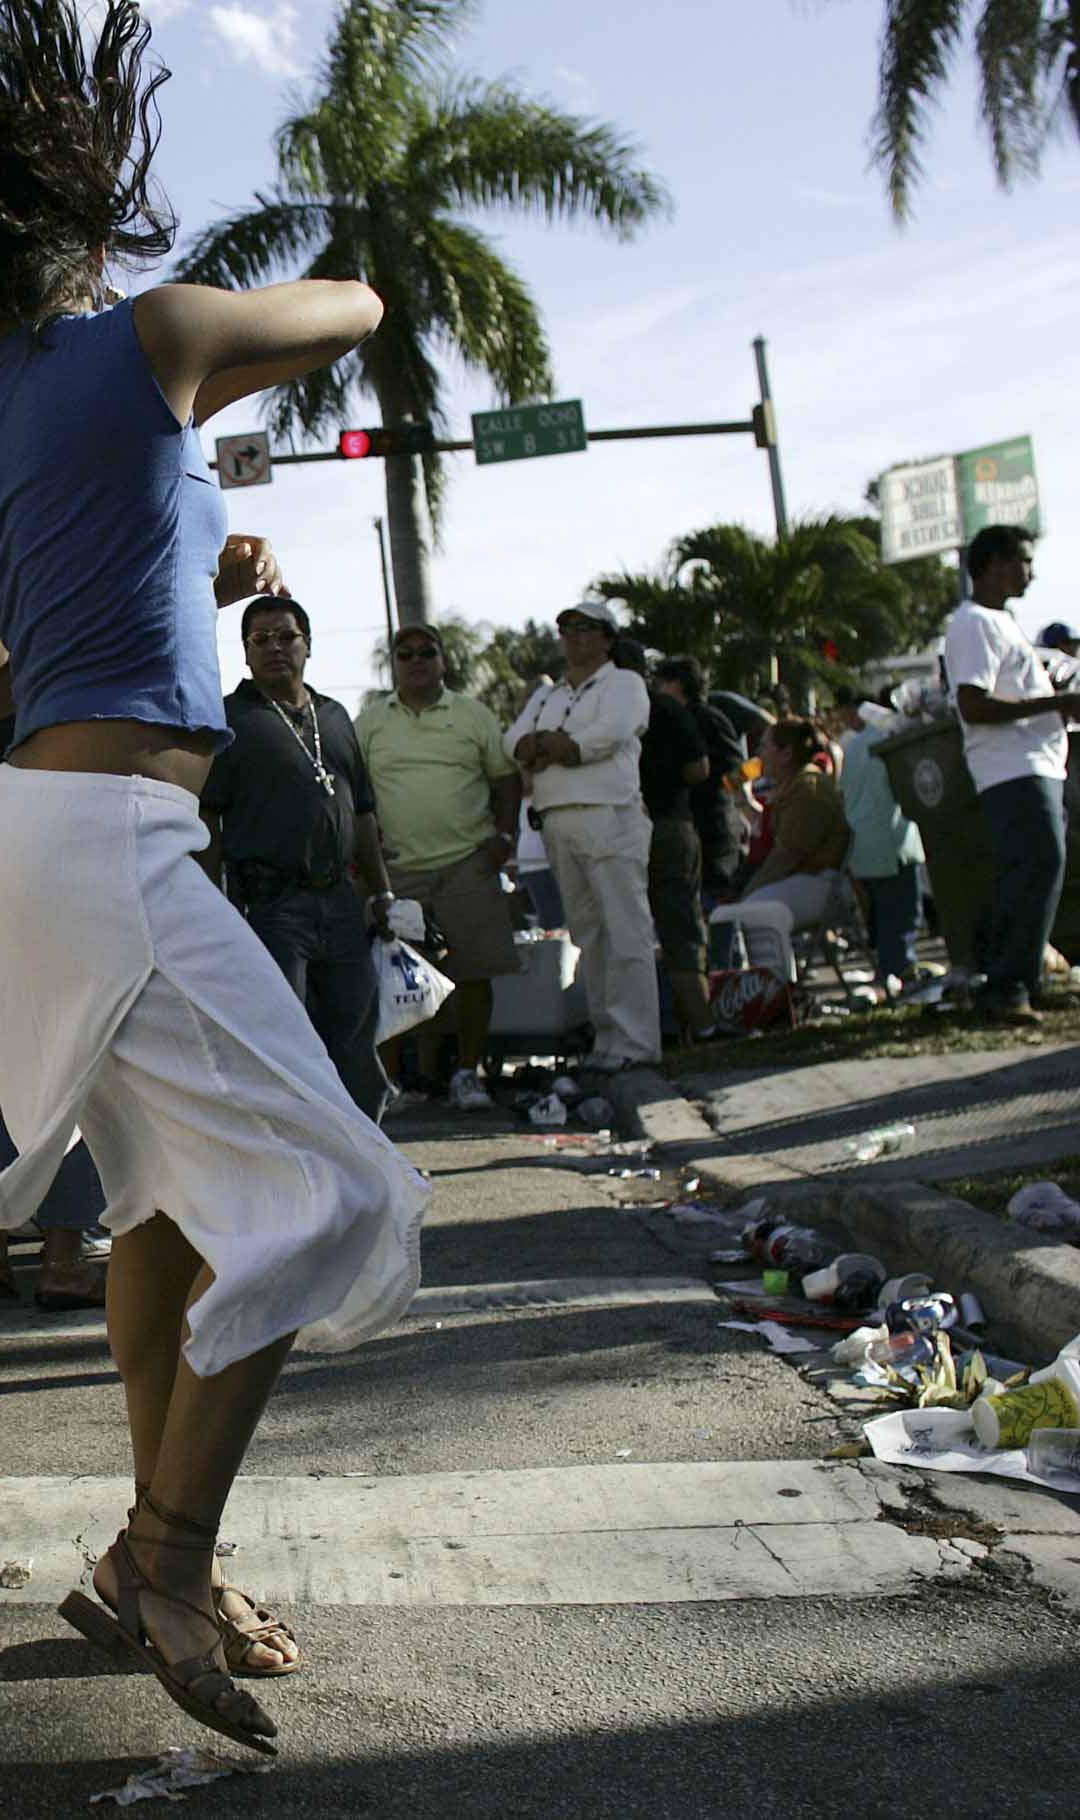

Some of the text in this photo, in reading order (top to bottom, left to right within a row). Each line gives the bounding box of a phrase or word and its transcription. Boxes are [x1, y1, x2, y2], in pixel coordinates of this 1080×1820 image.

[477, 405, 579, 434] CALLE OCHO
[480, 428, 580, 458] SW 8 ST
